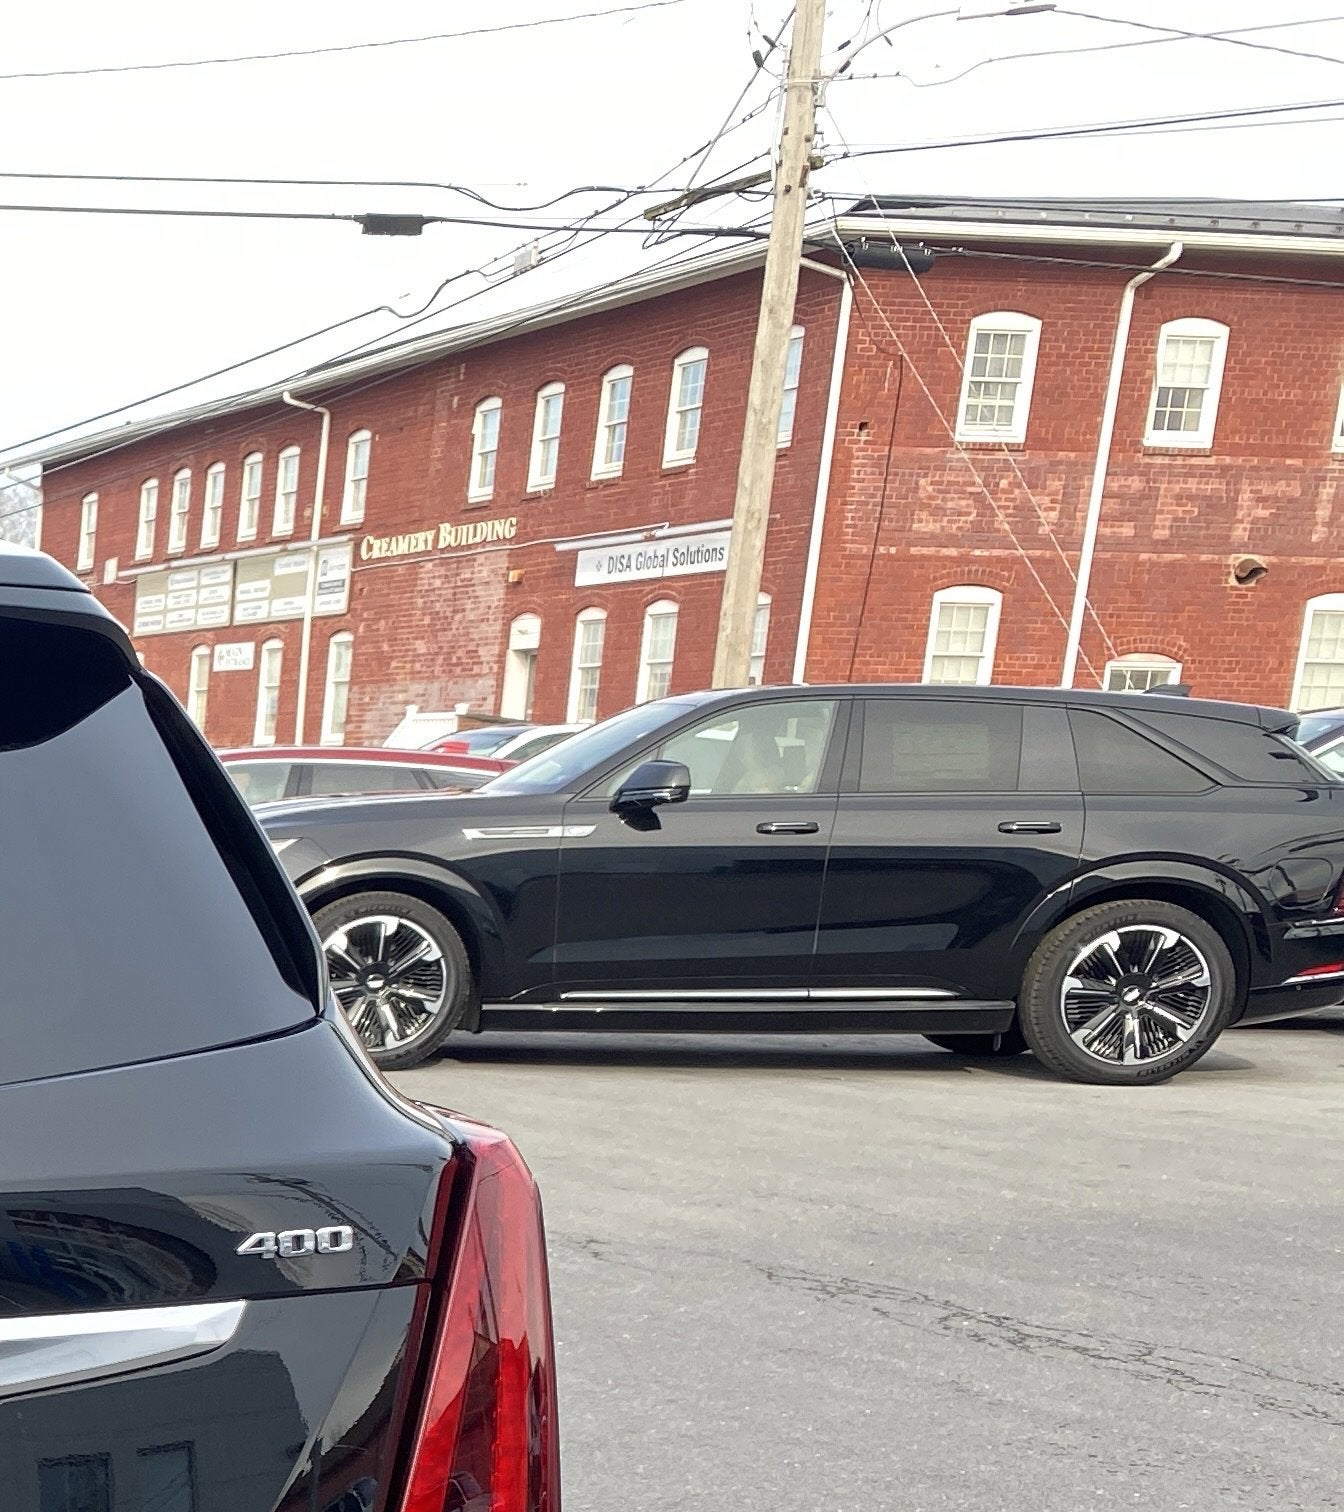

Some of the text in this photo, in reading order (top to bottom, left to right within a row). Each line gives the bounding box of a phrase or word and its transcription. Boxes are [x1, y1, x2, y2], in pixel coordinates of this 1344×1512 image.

[360, 517, 517, 560] CREAMERY BUILDING
[607, 543, 725, 574] DISA Global Solutions
[236, 1225, 354, 1260] 400
